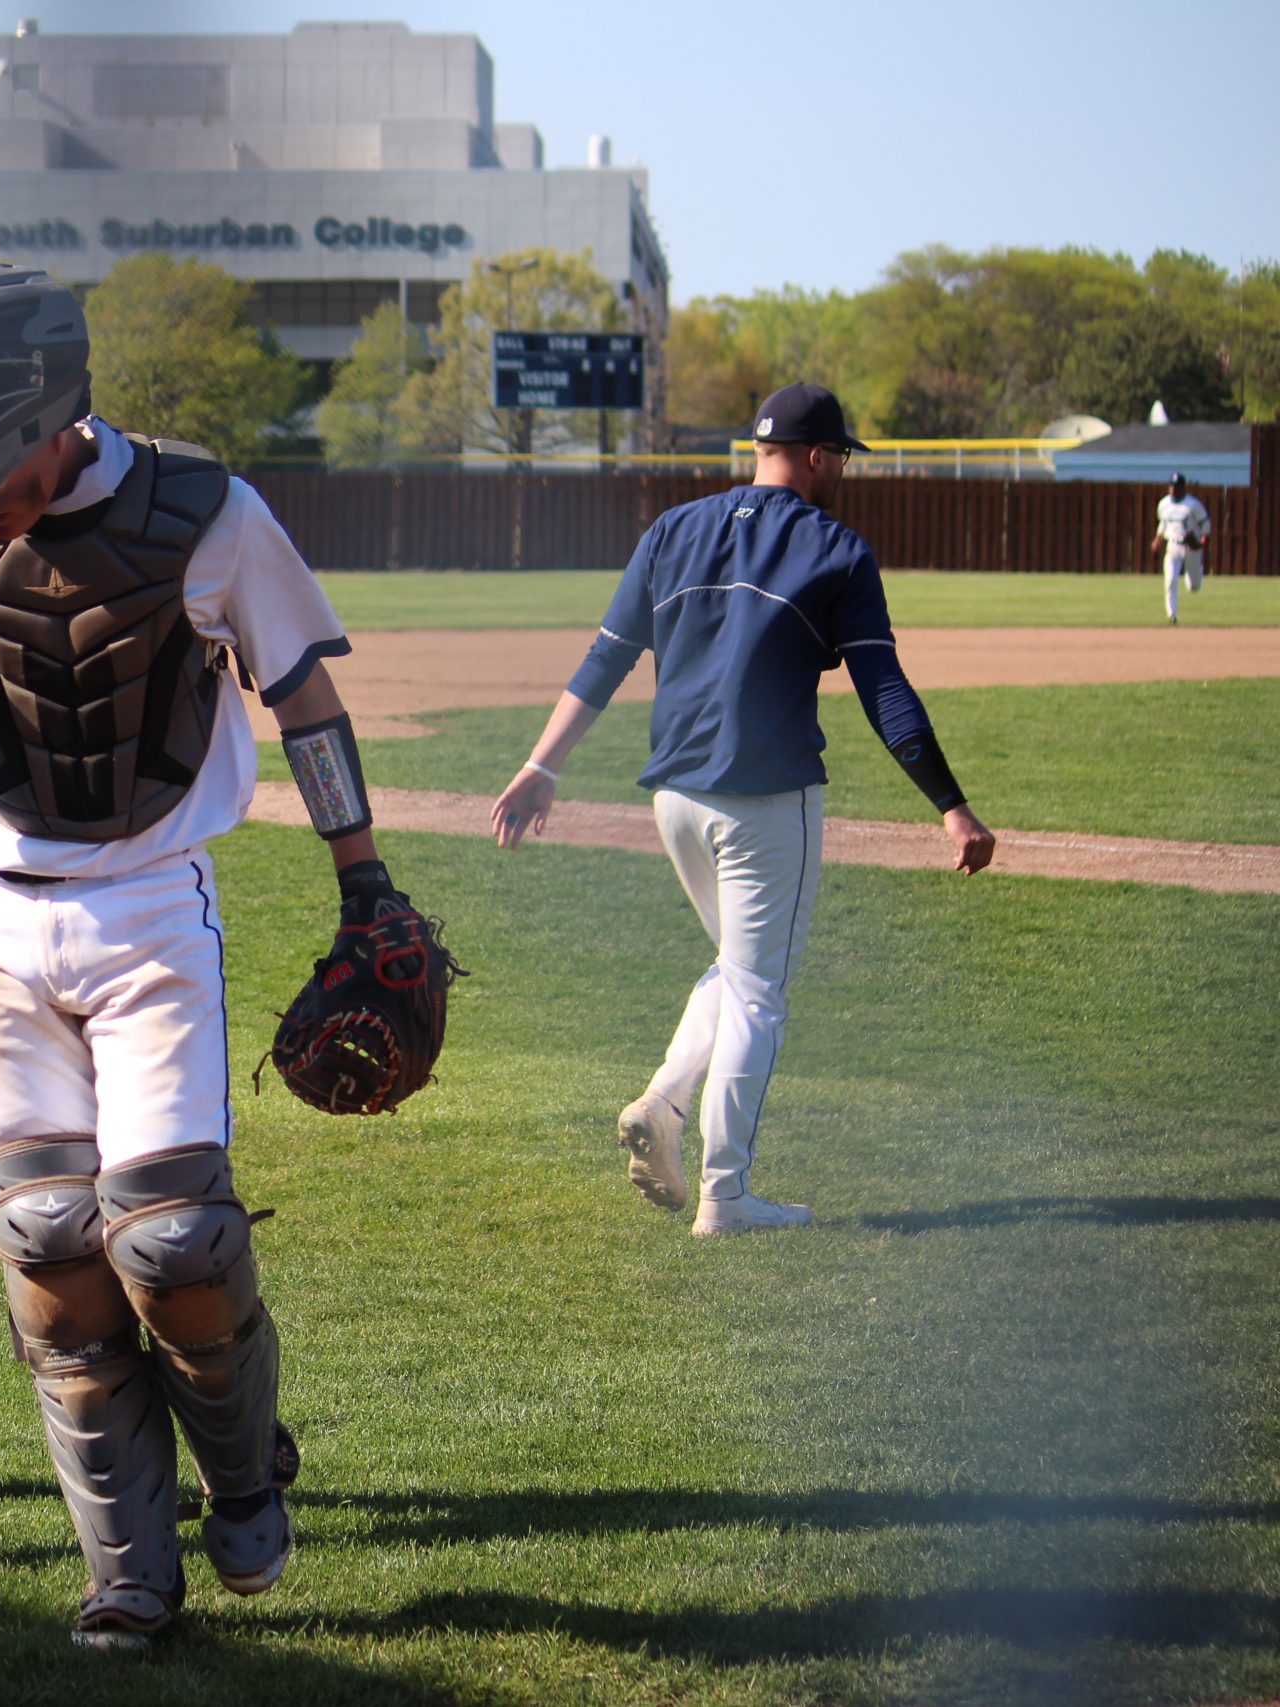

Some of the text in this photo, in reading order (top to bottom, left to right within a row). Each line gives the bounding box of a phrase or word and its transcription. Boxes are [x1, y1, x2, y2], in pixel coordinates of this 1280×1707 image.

[99, 217, 295, 247] Suburban
[313, 216, 467, 254] College
[735, 507, 755, 518] 27
